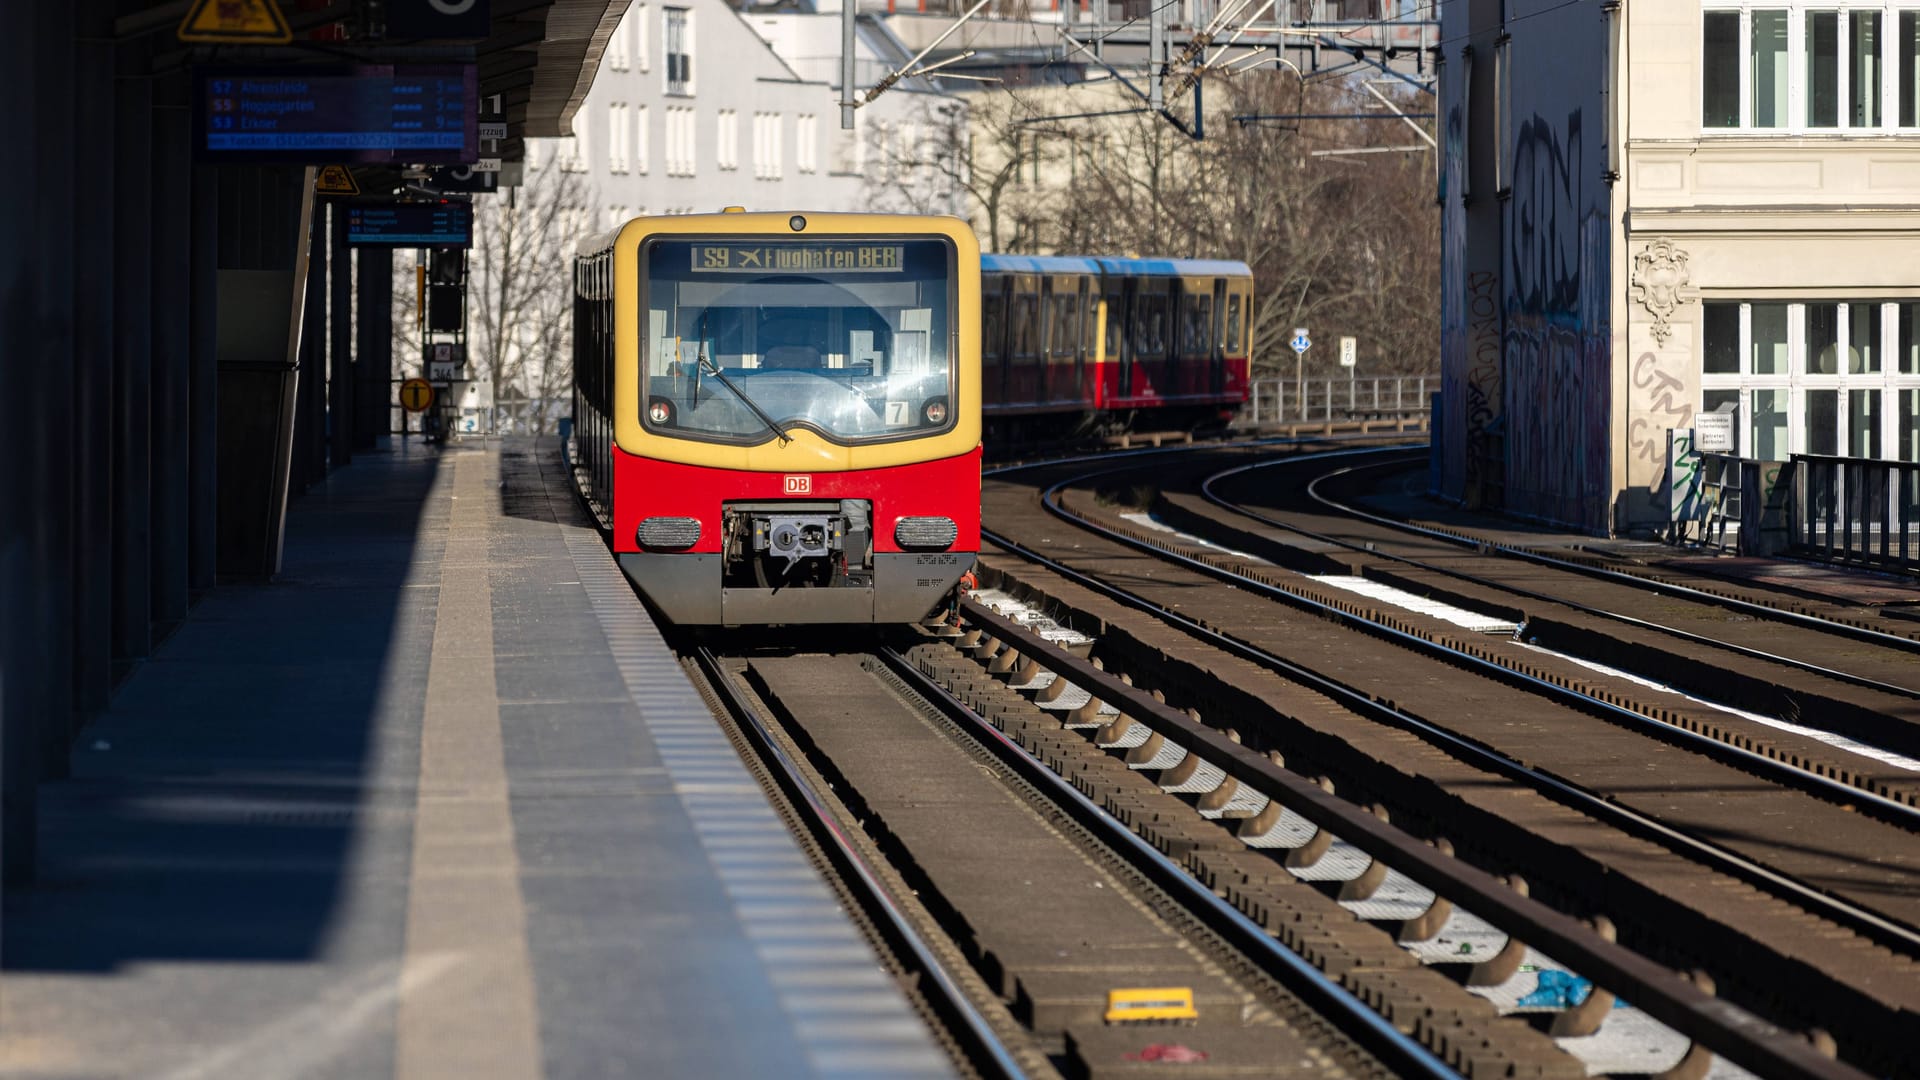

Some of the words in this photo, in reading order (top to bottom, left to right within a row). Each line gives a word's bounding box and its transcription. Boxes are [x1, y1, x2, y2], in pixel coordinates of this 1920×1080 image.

[213, 99, 232, 112] S5
[241, 98, 315, 115] Hoppegarten
[241, 116, 278, 129] Erkner
[703, 247, 730, 268] S9
[765, 247, 854, 269] Flughafen
[858, 247, 897, 268] BER
[890, 402, 904, 424] 7
[787, 478, 808, 491] DB
